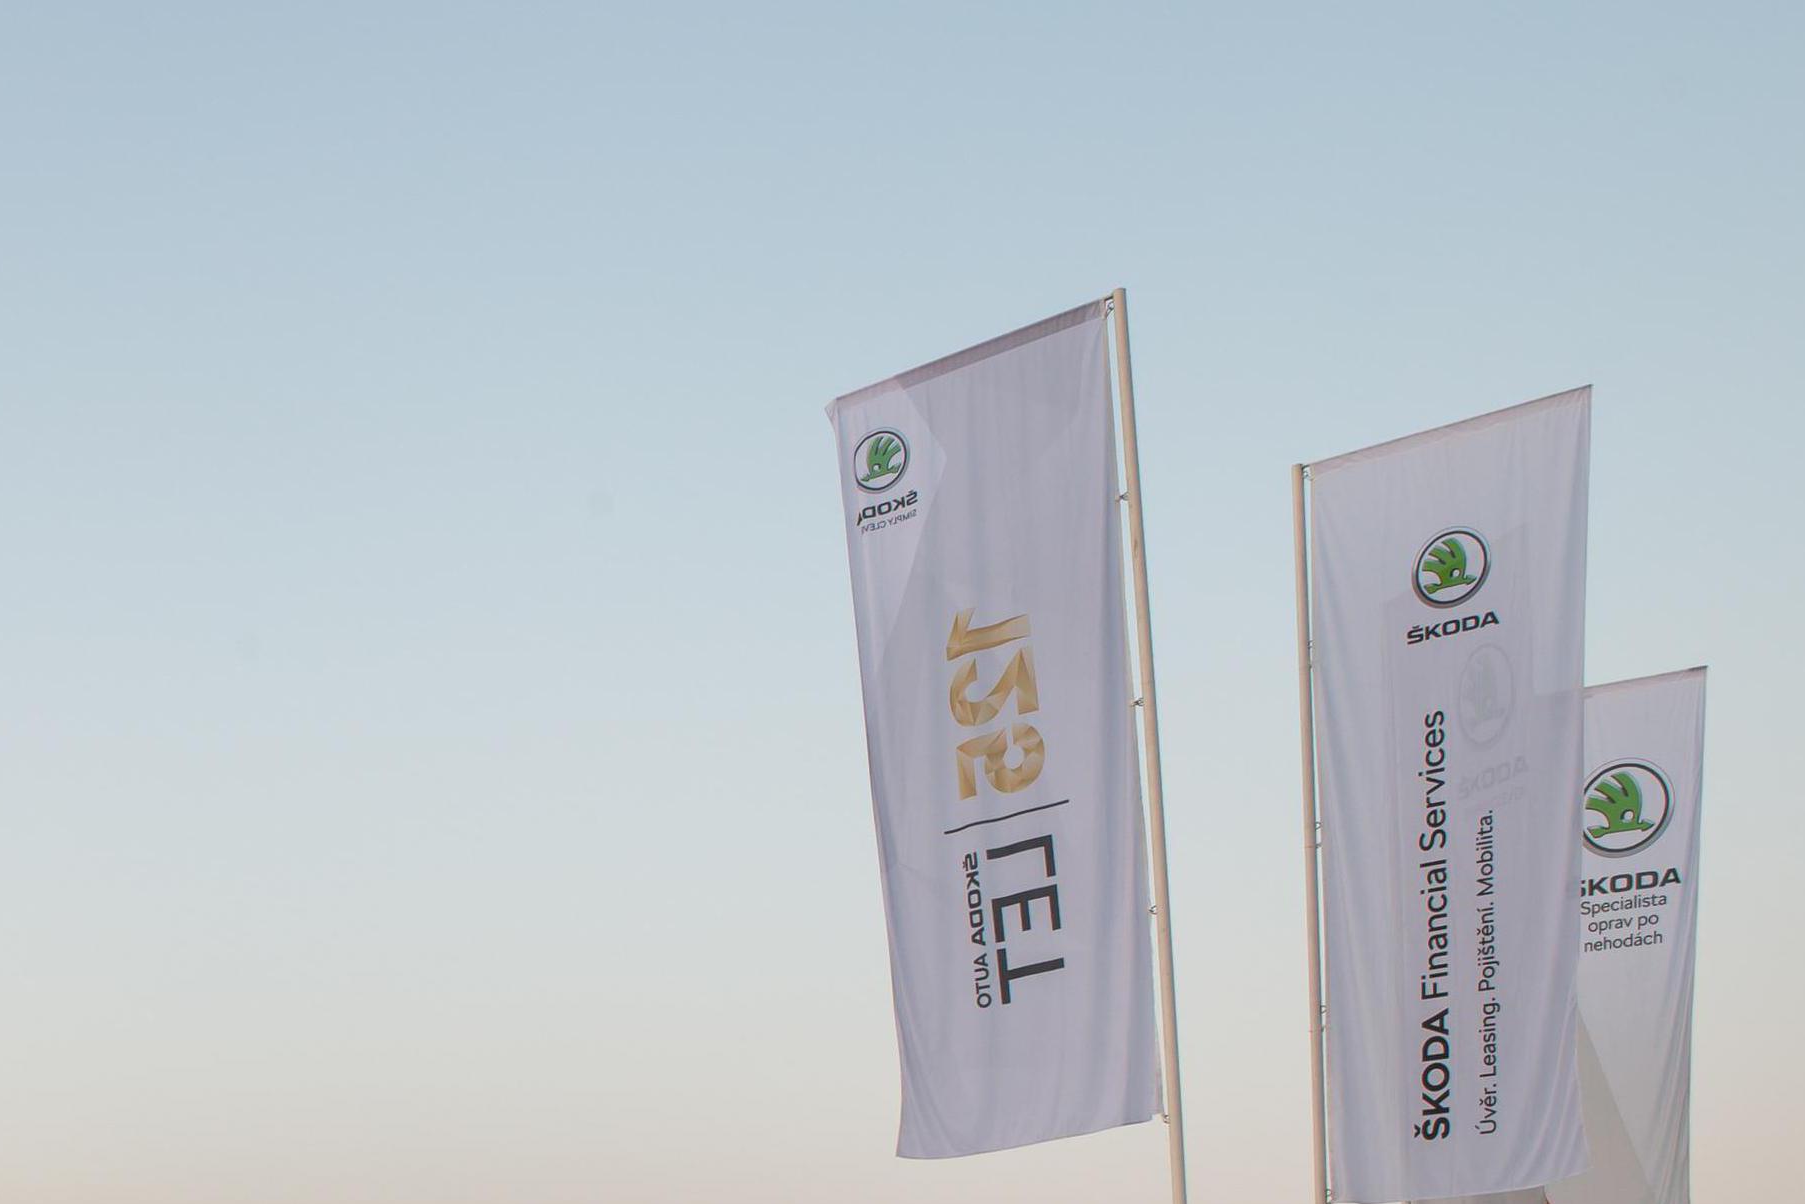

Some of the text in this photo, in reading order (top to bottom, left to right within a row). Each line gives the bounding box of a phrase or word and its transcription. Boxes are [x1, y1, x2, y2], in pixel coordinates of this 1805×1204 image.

[1406, 611, 1500, 645] ŠKODA
[1580, 894, 1668, 918] Specialista
[1414, 710, 1450, 1140] ŠKODA Financial Services
[1587, 914, 1660, 935] oprav po
[1583, 931, 1664, 953] nehodách
[1475, 809, 1500, 1135] Úvěr. Leasing. Pojištění. Mobilita.
